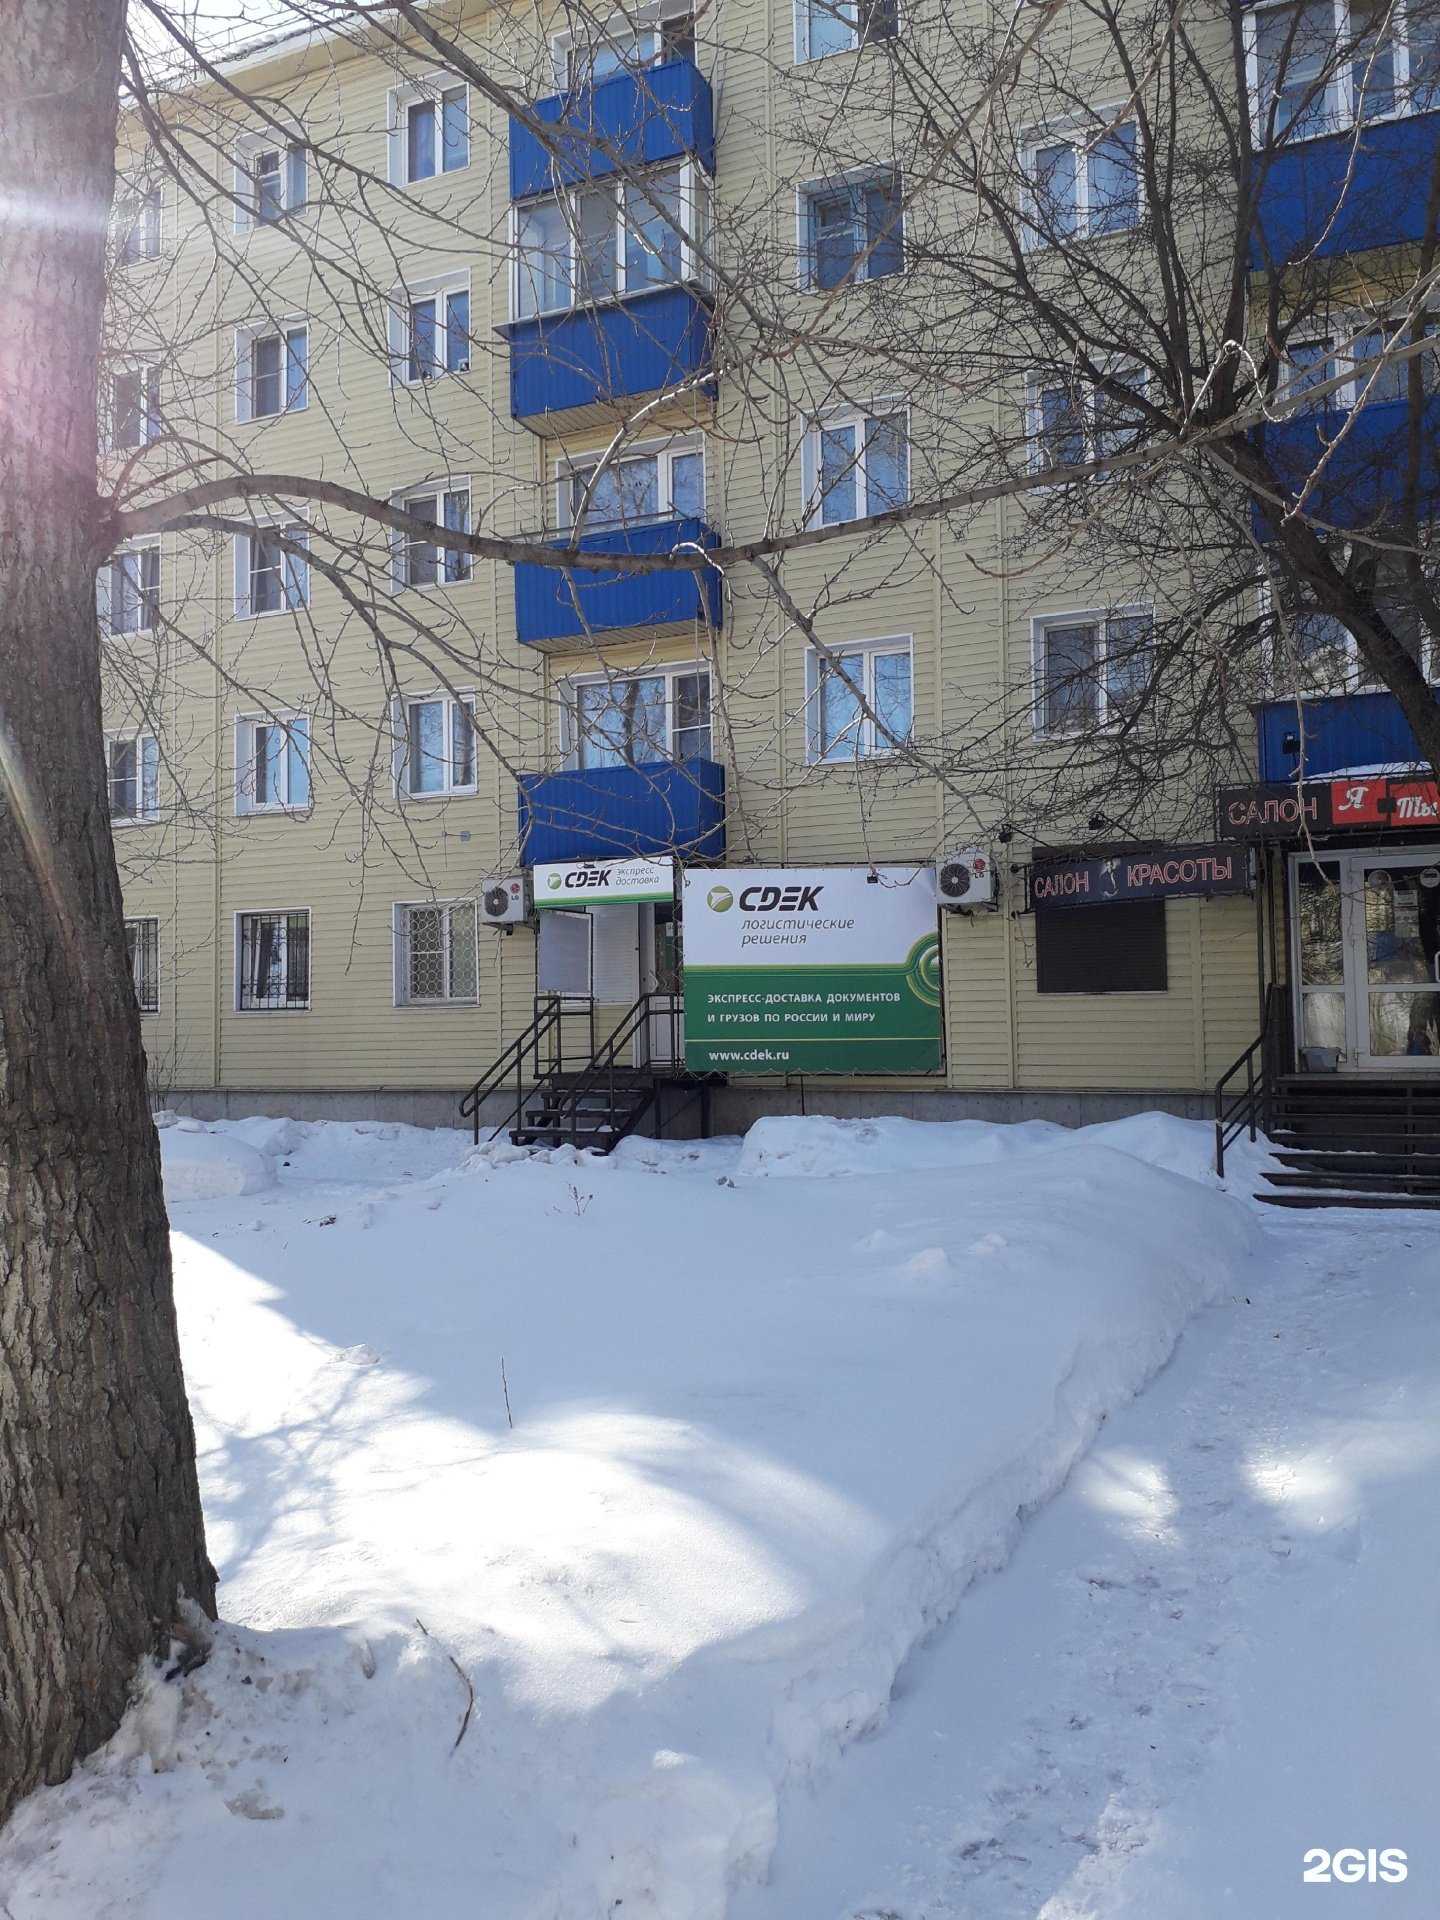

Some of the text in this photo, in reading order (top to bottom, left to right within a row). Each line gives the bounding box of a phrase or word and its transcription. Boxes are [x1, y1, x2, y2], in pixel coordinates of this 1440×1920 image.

[1338, 786, 1368, 811] Я
[1228, 797, 1317, 825] САЛОН
[616, 867, 655, 876] экспресс
[1034, 856, 1232, 898] САЛОН КРАСОТЫ
[565, 869, 612, 888] CDEK
[616, 875, 660, 886] доставка
[739, 886, 824, 912] CDEK
[741, 919, 855, 930] логистические
[741, 934, 807, 947] решения
[707, 993, 900, 1005] ЭКСПРЕСС-ДОСТАВКА ДОКУМЕНТОВ
[707, 1013, 875, 1022] И ГРУЗОВ ПО РОССИИ И МИРУ
[709, 1049, 790, 1061] www.cdek.ru
